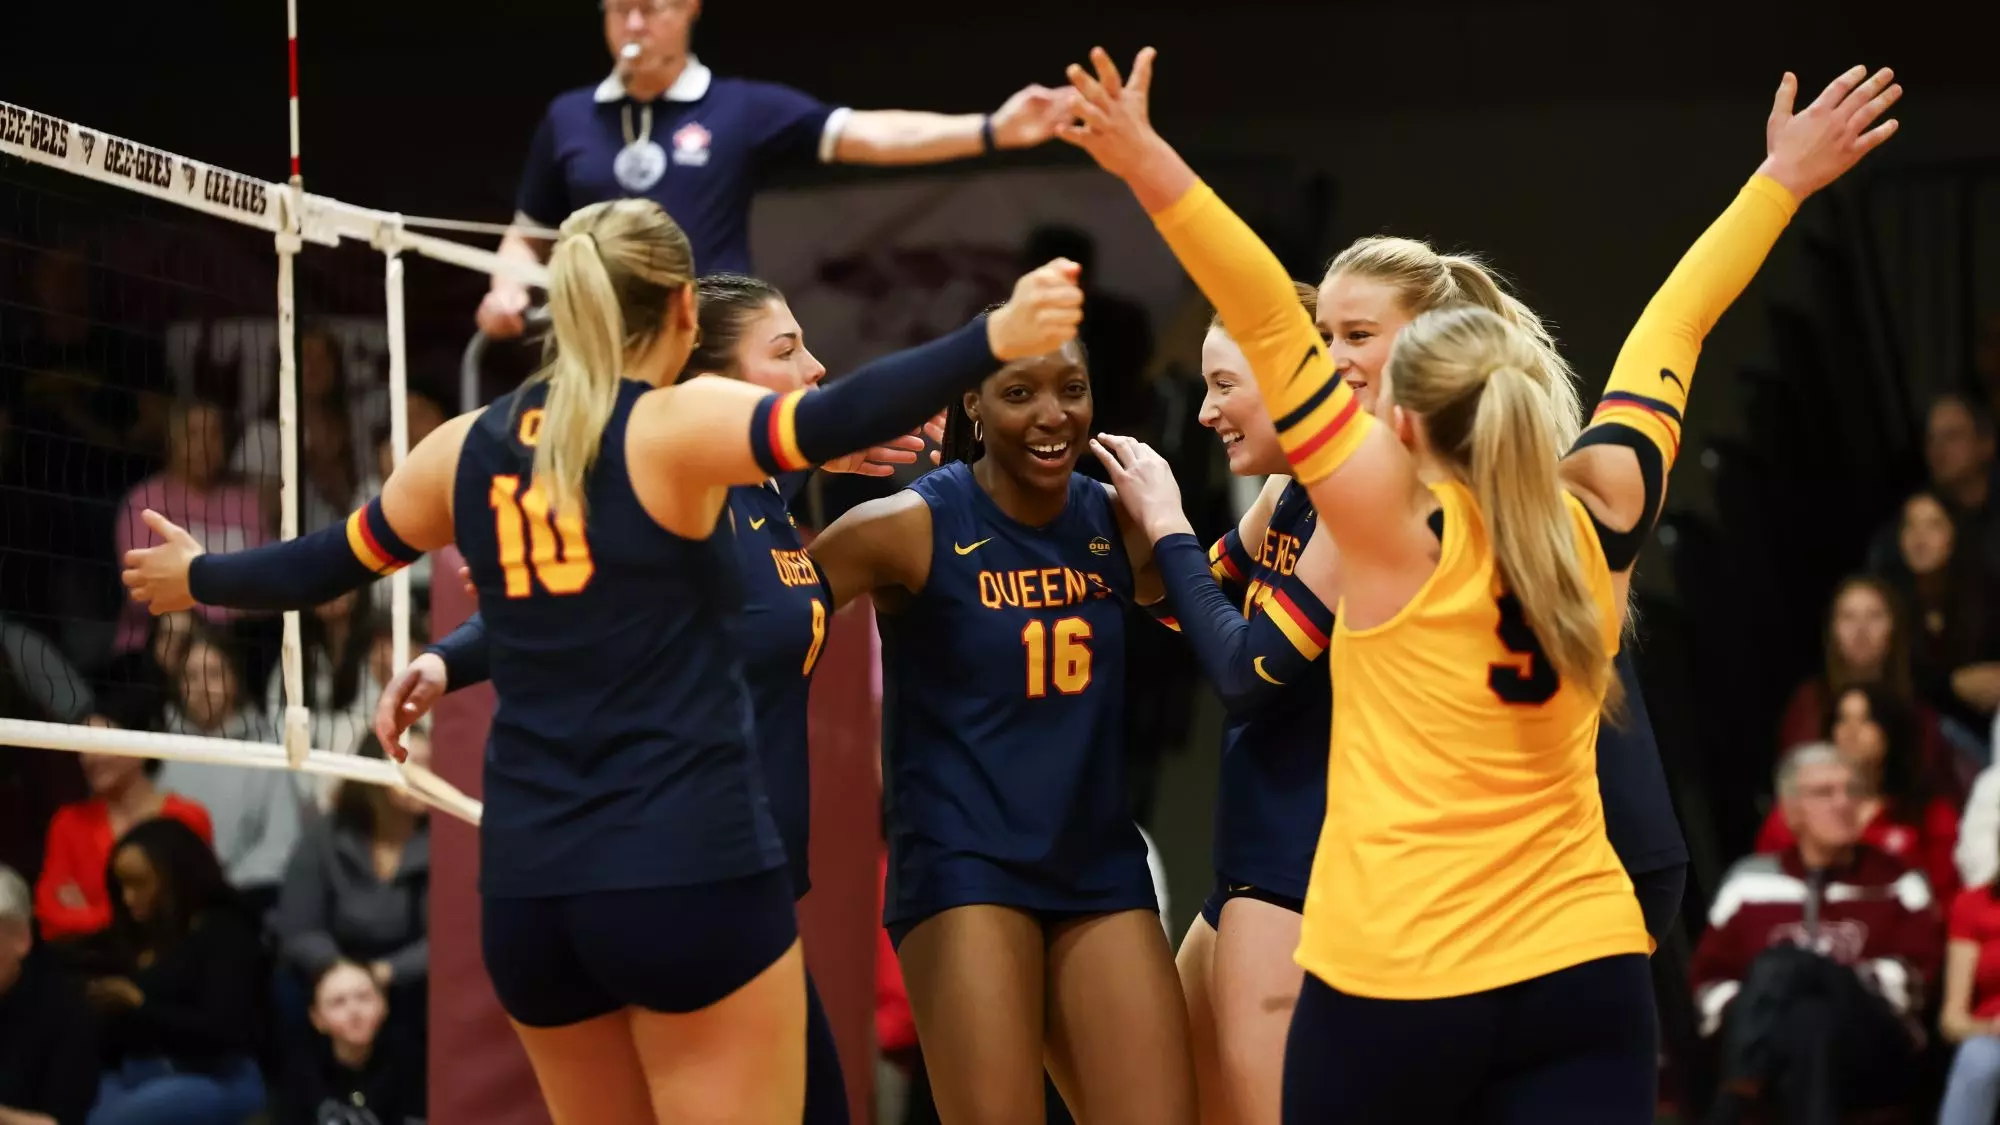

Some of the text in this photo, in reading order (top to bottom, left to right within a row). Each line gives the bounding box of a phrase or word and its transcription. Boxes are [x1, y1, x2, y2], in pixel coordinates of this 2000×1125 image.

[104, 138, 173, 189] GEE-GEES
[488, 474, 596, 599] 10
[1020, 615, 1096, 699] 16
